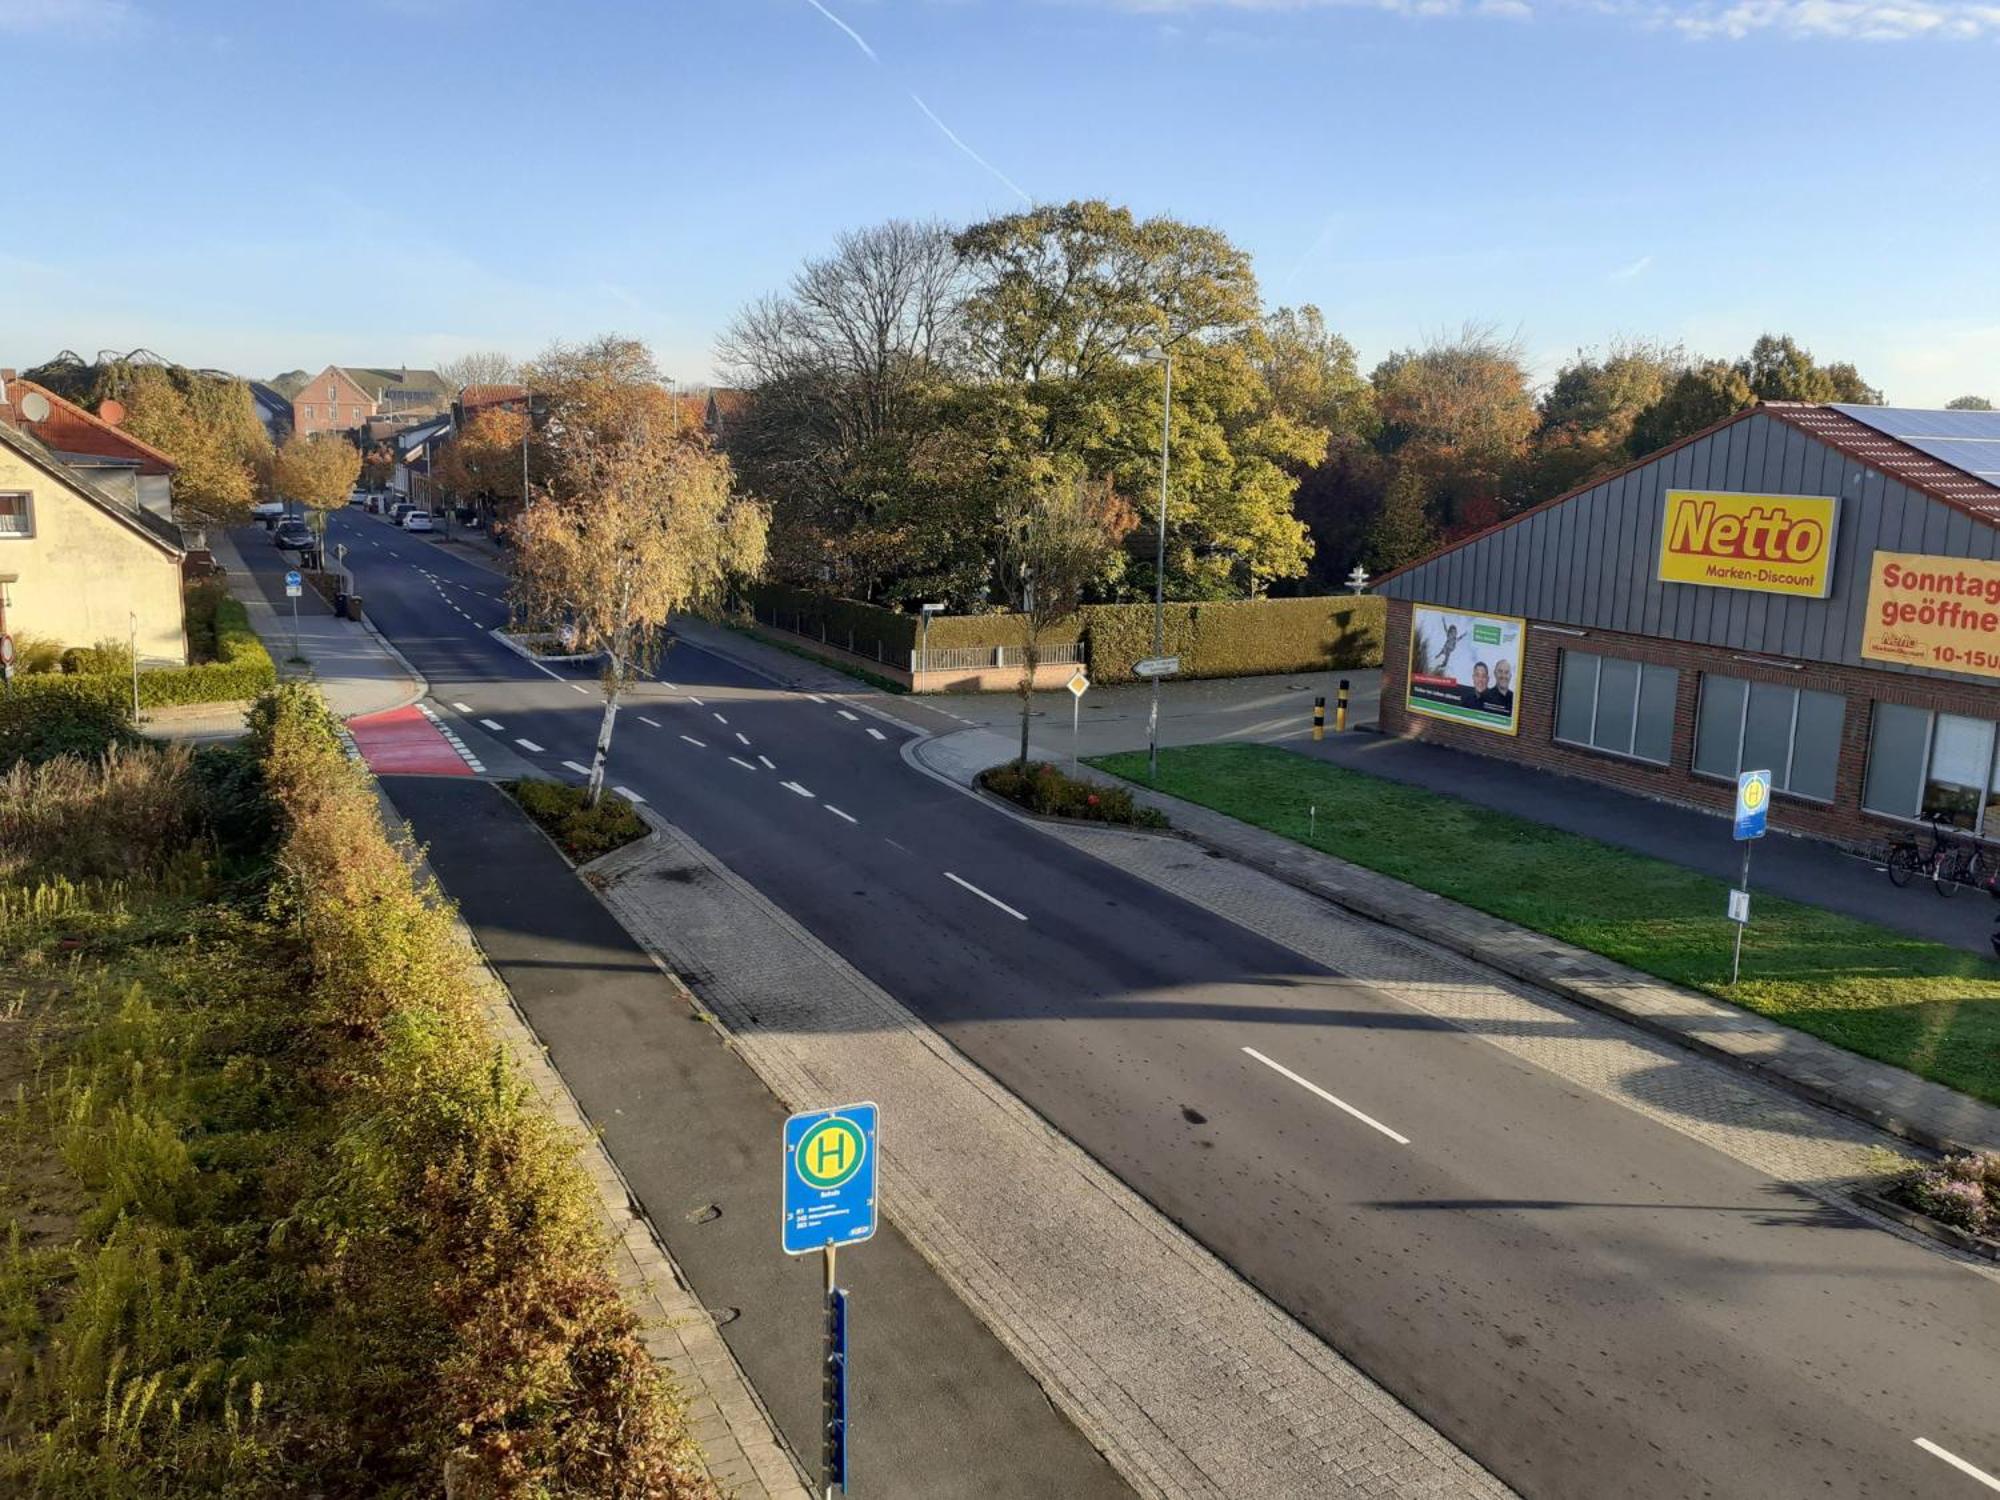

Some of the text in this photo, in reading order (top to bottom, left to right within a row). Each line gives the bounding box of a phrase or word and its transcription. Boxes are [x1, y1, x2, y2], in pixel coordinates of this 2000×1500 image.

[1669, 500, 1823, 564] Netto
[1706, 564, 1815, 587] Marken-Discount
[1881, 597, 1999, 632] geöffne
[817, 1132, 845, 1174] H
